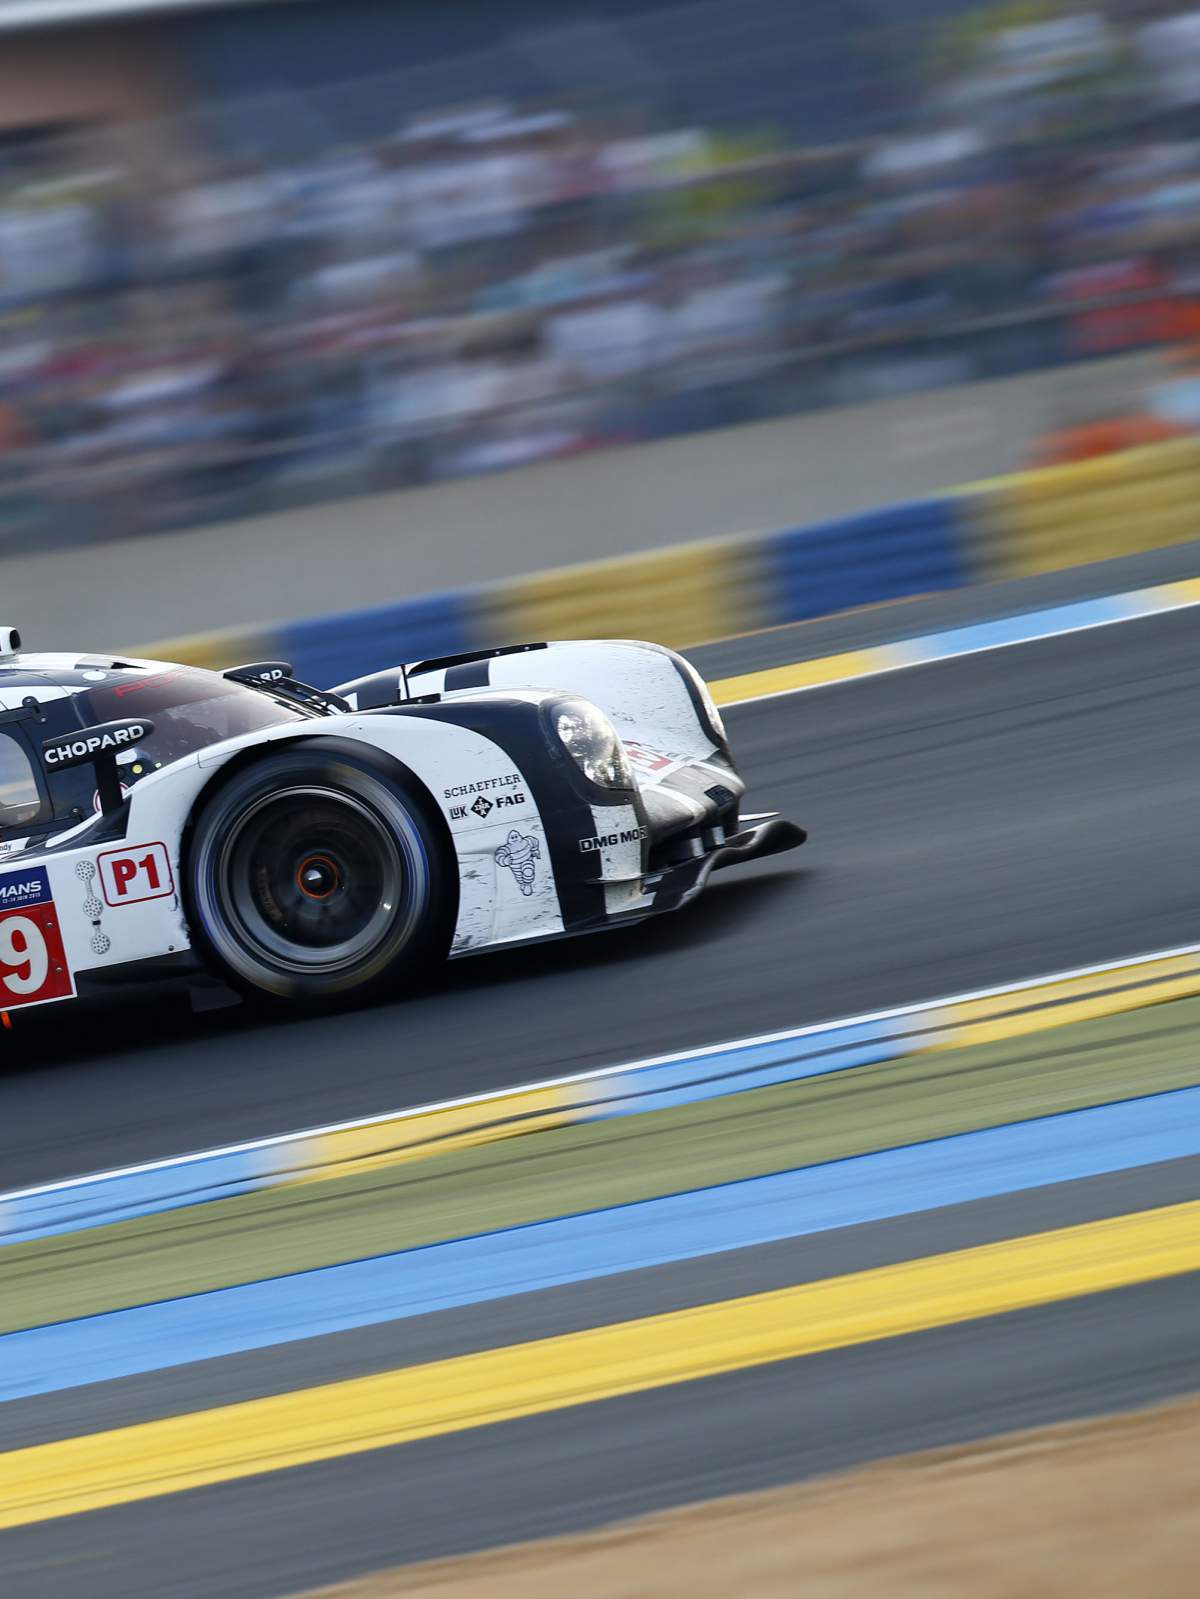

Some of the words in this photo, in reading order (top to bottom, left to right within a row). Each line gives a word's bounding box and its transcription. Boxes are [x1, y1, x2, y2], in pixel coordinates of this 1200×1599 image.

[44, 725, 144, 763] CHOPARD
[444, 774, 521, 798] SCHAEFFLER
[496, 793, 525, 808] FAG
[581, 834, 618, 850] DMG
[620, 828, 648, 843] MOR
[111, 854, 160, 895] P1
